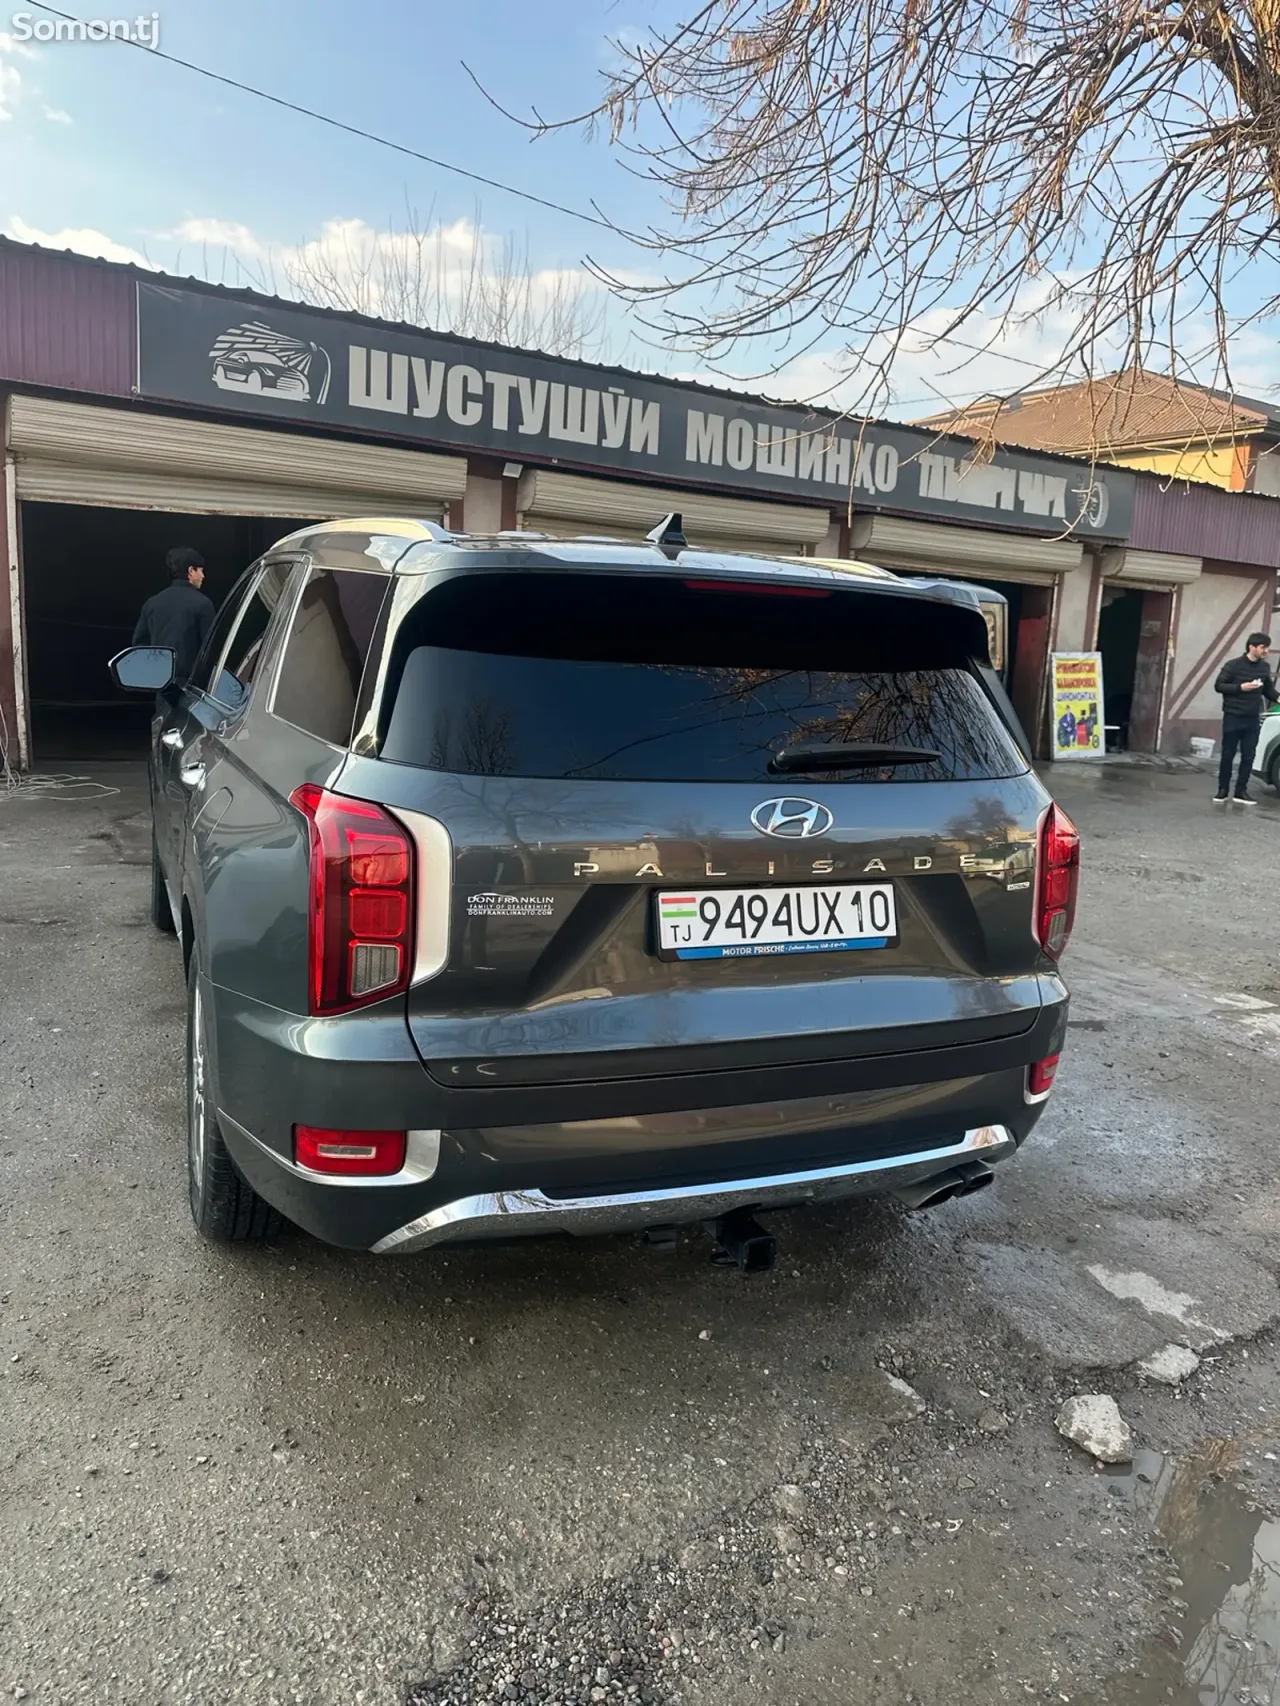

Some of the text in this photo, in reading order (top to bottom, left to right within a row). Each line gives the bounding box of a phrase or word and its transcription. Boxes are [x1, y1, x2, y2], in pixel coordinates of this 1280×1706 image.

[573, 853, 977, 877] PALISADE
[467, 896, 554, 904] DON FRANKLIN
[670, 924, 692, 943] TJ
[722, 946, 752, 956] MOTOR
